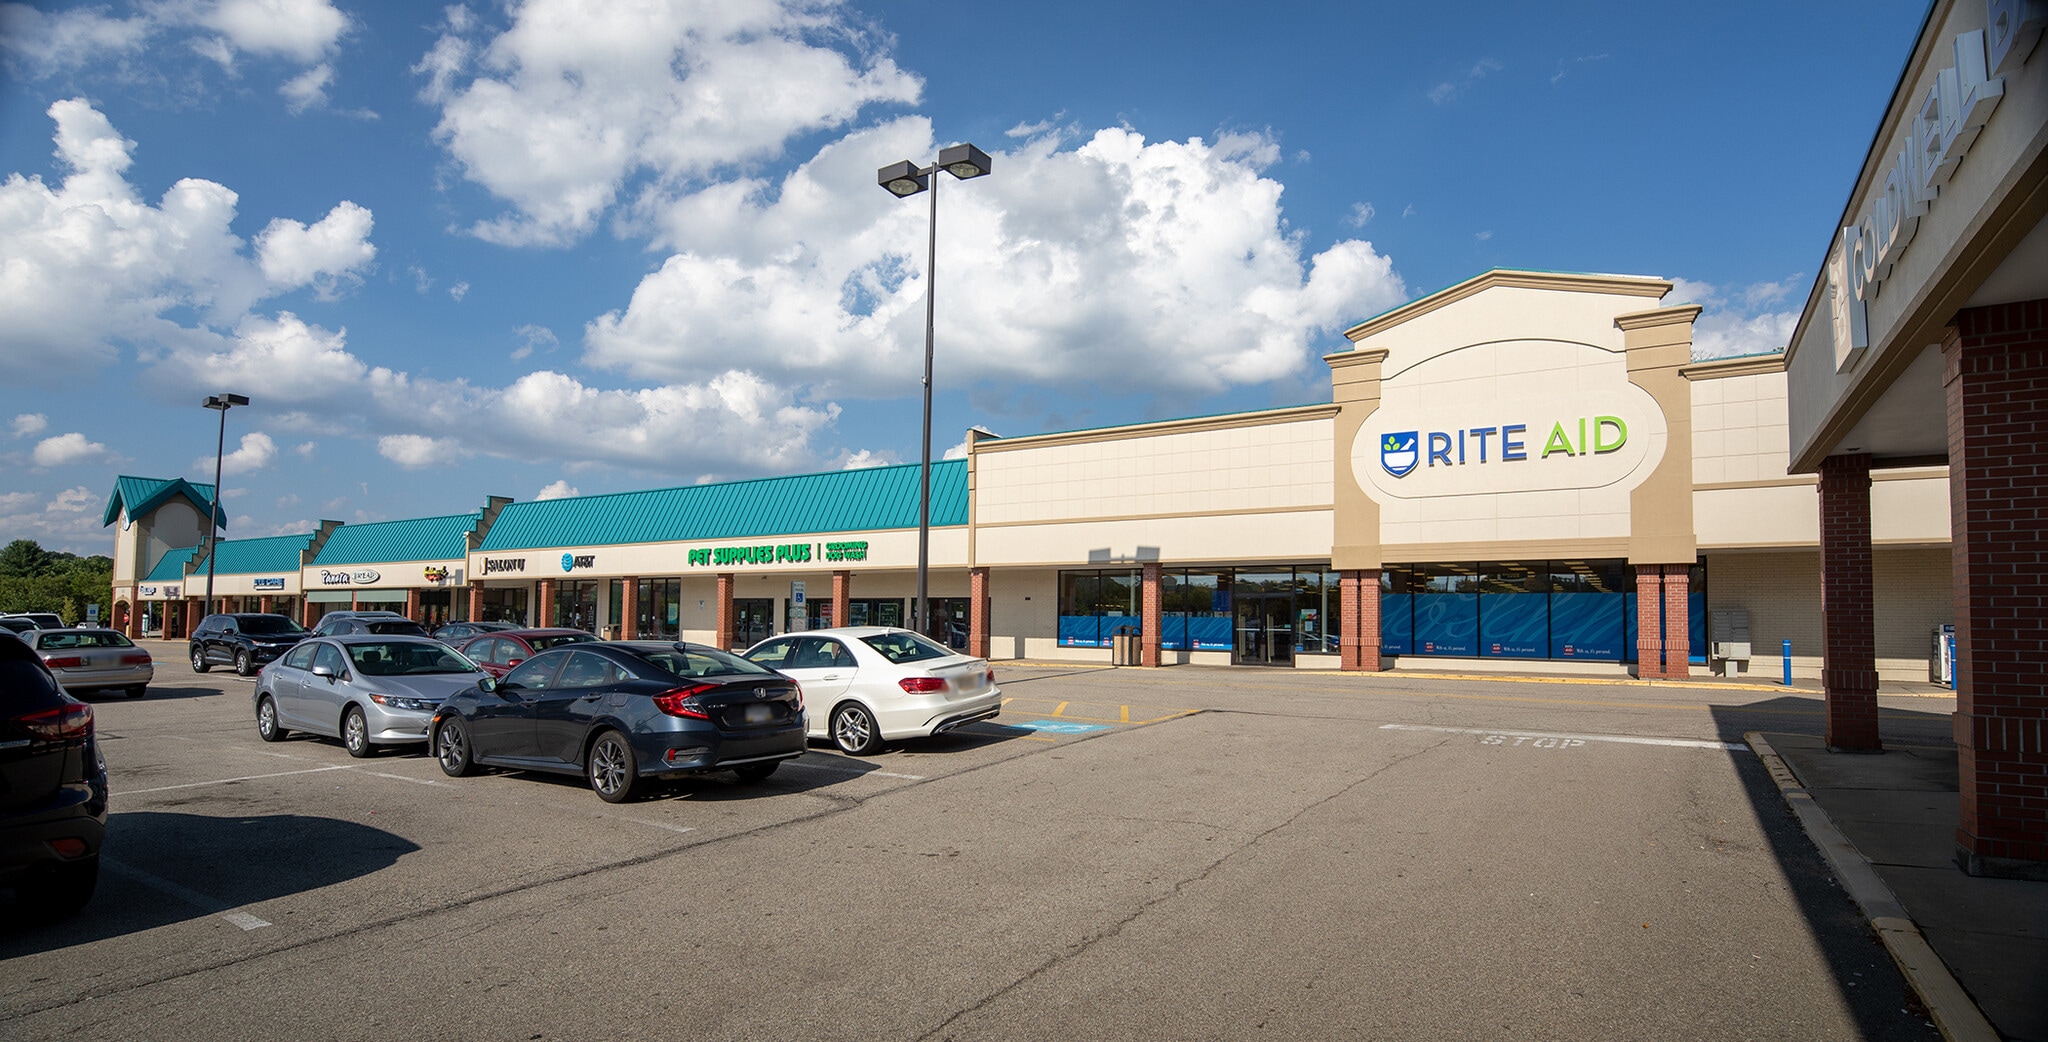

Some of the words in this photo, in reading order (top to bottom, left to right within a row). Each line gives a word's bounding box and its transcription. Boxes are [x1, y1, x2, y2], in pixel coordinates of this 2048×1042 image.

[1853, 29, 2006, 302] COLDWELL
[1427, 423, 1528, 468] RITE
[1541, 415, 1629, 460] AID
[826, 541, 868, 551] GROOMING
[574, 555, 595, 568] AT&T
[688, 549, 712, 567] PET
[713, 545, 775, 565] SUPPLIES
[775, 543, 811, 563] PLUS
[826, 551, 844, 562] DOG
[844, 551, 867, 561] WASH
[1480, 735, 1586, 750] STOP
